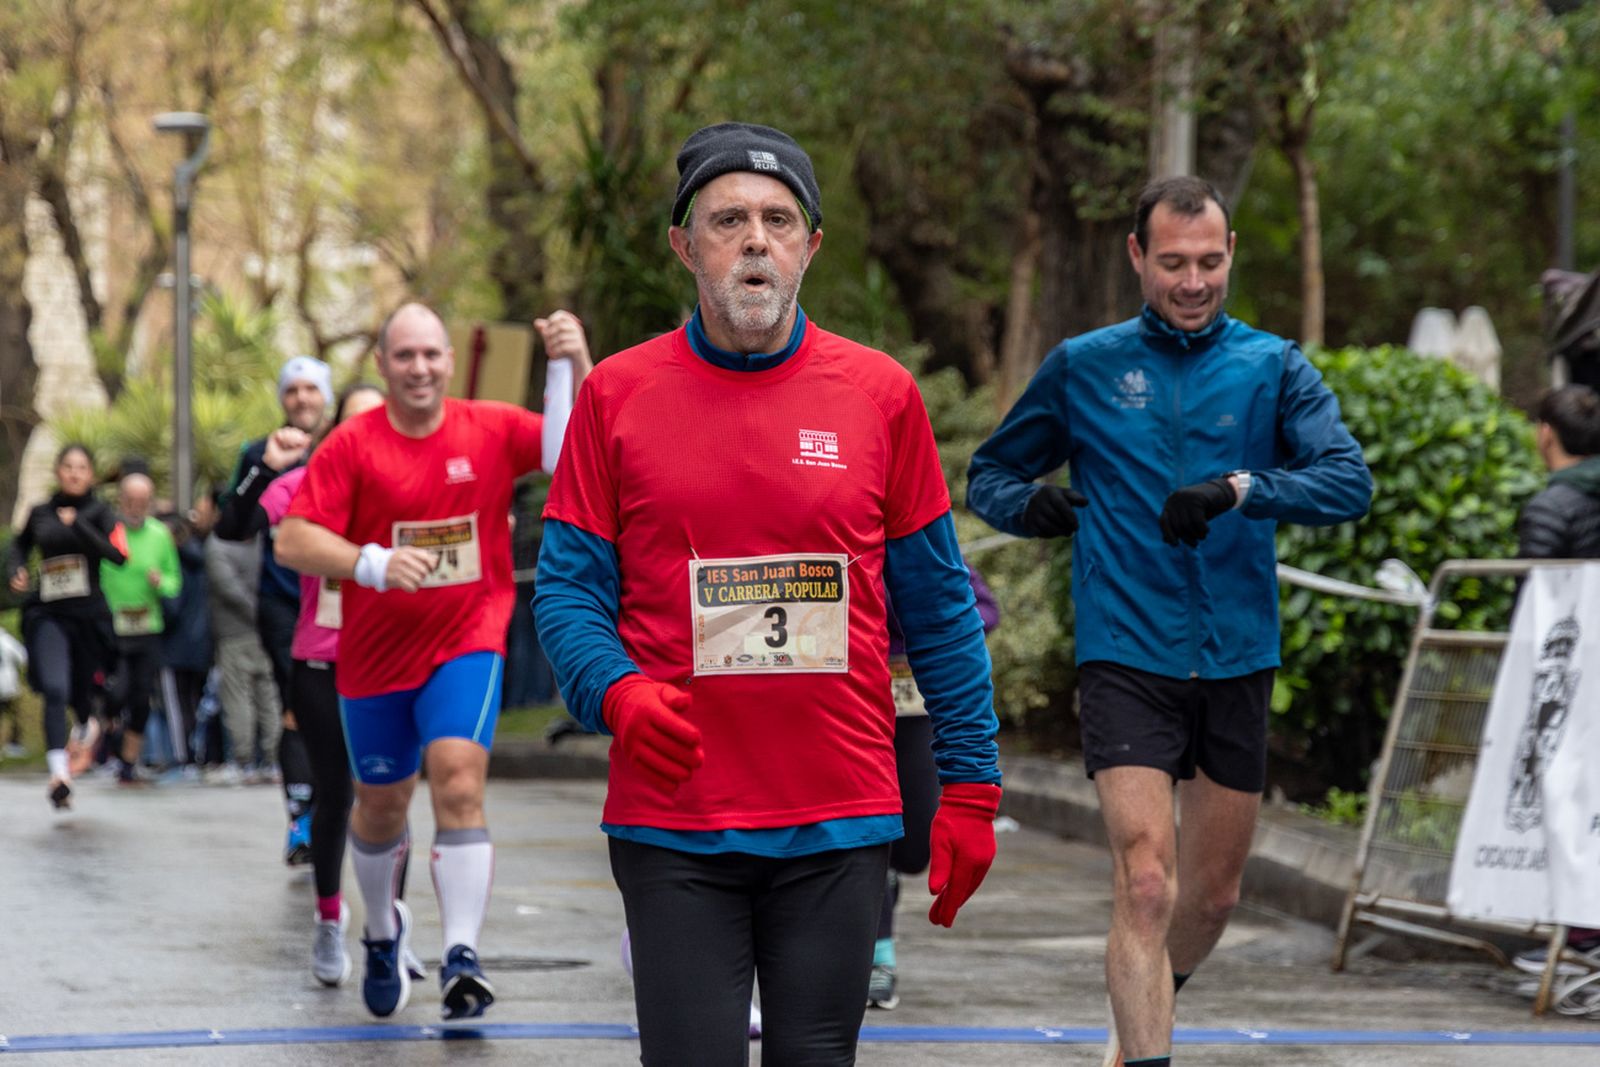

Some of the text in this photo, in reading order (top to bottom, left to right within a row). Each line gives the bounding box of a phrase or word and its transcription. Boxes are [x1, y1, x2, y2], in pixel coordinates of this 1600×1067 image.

[706, 562, 834, 584] IES San Juan Bosco
[703, 581, 838, 604] V CARRERA POPULAR
[764, 606, 788, 648] 3
